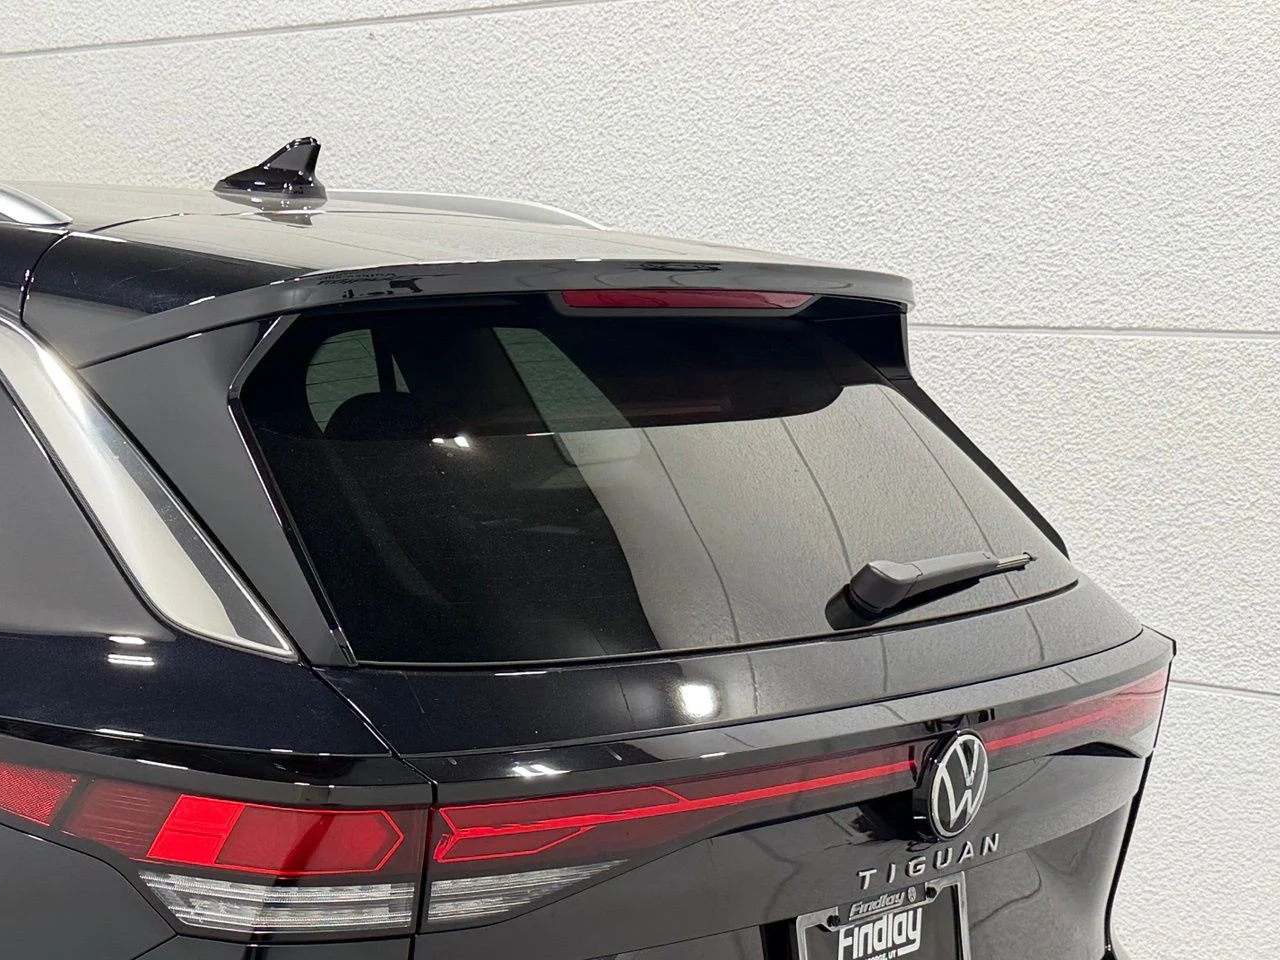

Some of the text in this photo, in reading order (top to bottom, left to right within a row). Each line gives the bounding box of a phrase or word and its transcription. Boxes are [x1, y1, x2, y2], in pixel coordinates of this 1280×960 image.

[857, 833, 1000, 890] TIGUAN
[849, 891, 906, 919] Findlay
[888, 949, 897, 960] UT
